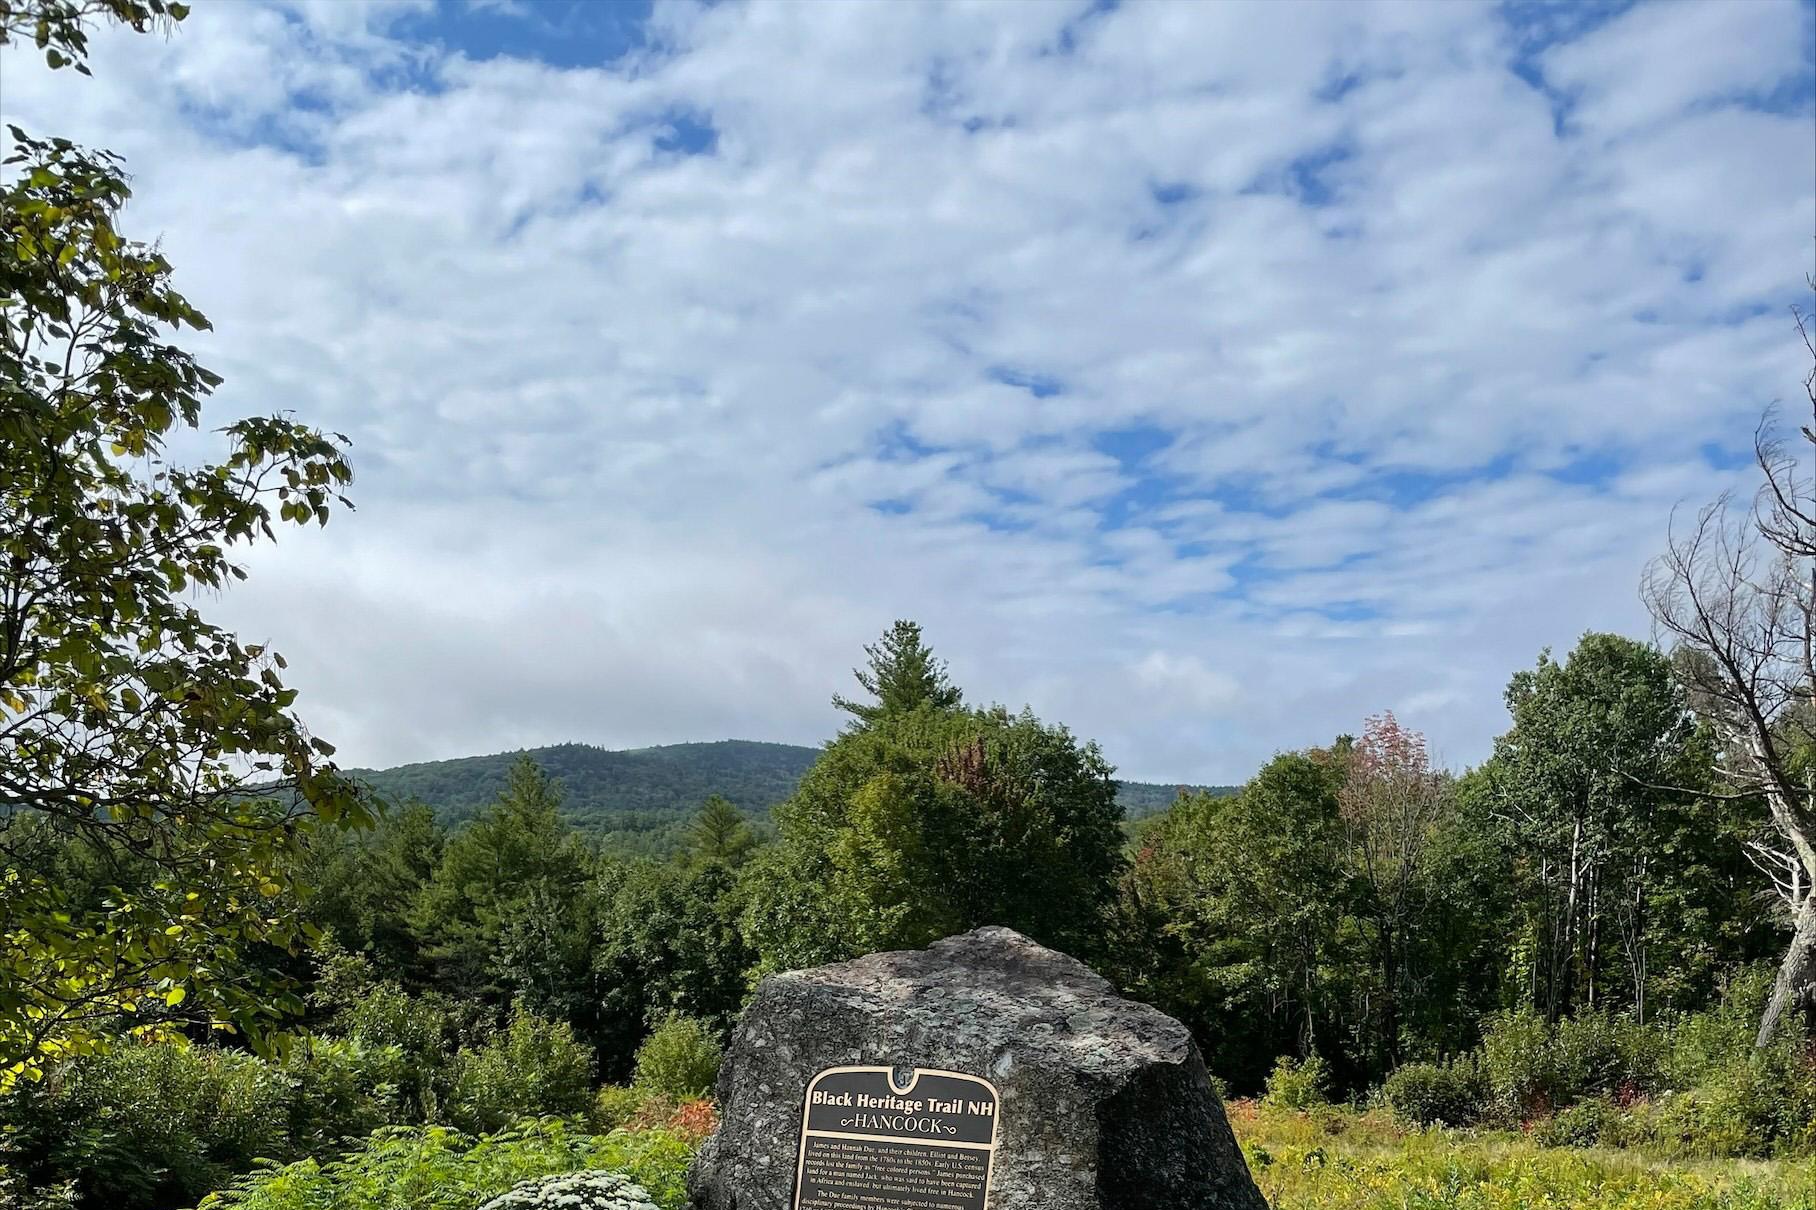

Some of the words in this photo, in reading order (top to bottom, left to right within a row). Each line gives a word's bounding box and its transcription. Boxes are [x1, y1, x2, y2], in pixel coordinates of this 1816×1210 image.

[812, 1090, 853, 1107] Black
[856, 1094, 923, 1115] Heritage
[928, 1098, 963, 1115] Trail
[967, 1101, 994, 1116] NH
[854, 1113, 942, 1134] HANCOCK
[845, 1162, 863, 1171] family
[956, 1172, 985, 1181] purchased
[883, 1184, 911, 1193] ultimately
[956, 1181, 981, 1191] captured
[801, 1198, 832, 1208] disciplinary
[841, 1192, 858, 1202] family
[860, 1194, 885, 1202] members
[901, 1198, 928, 1208] subjected
